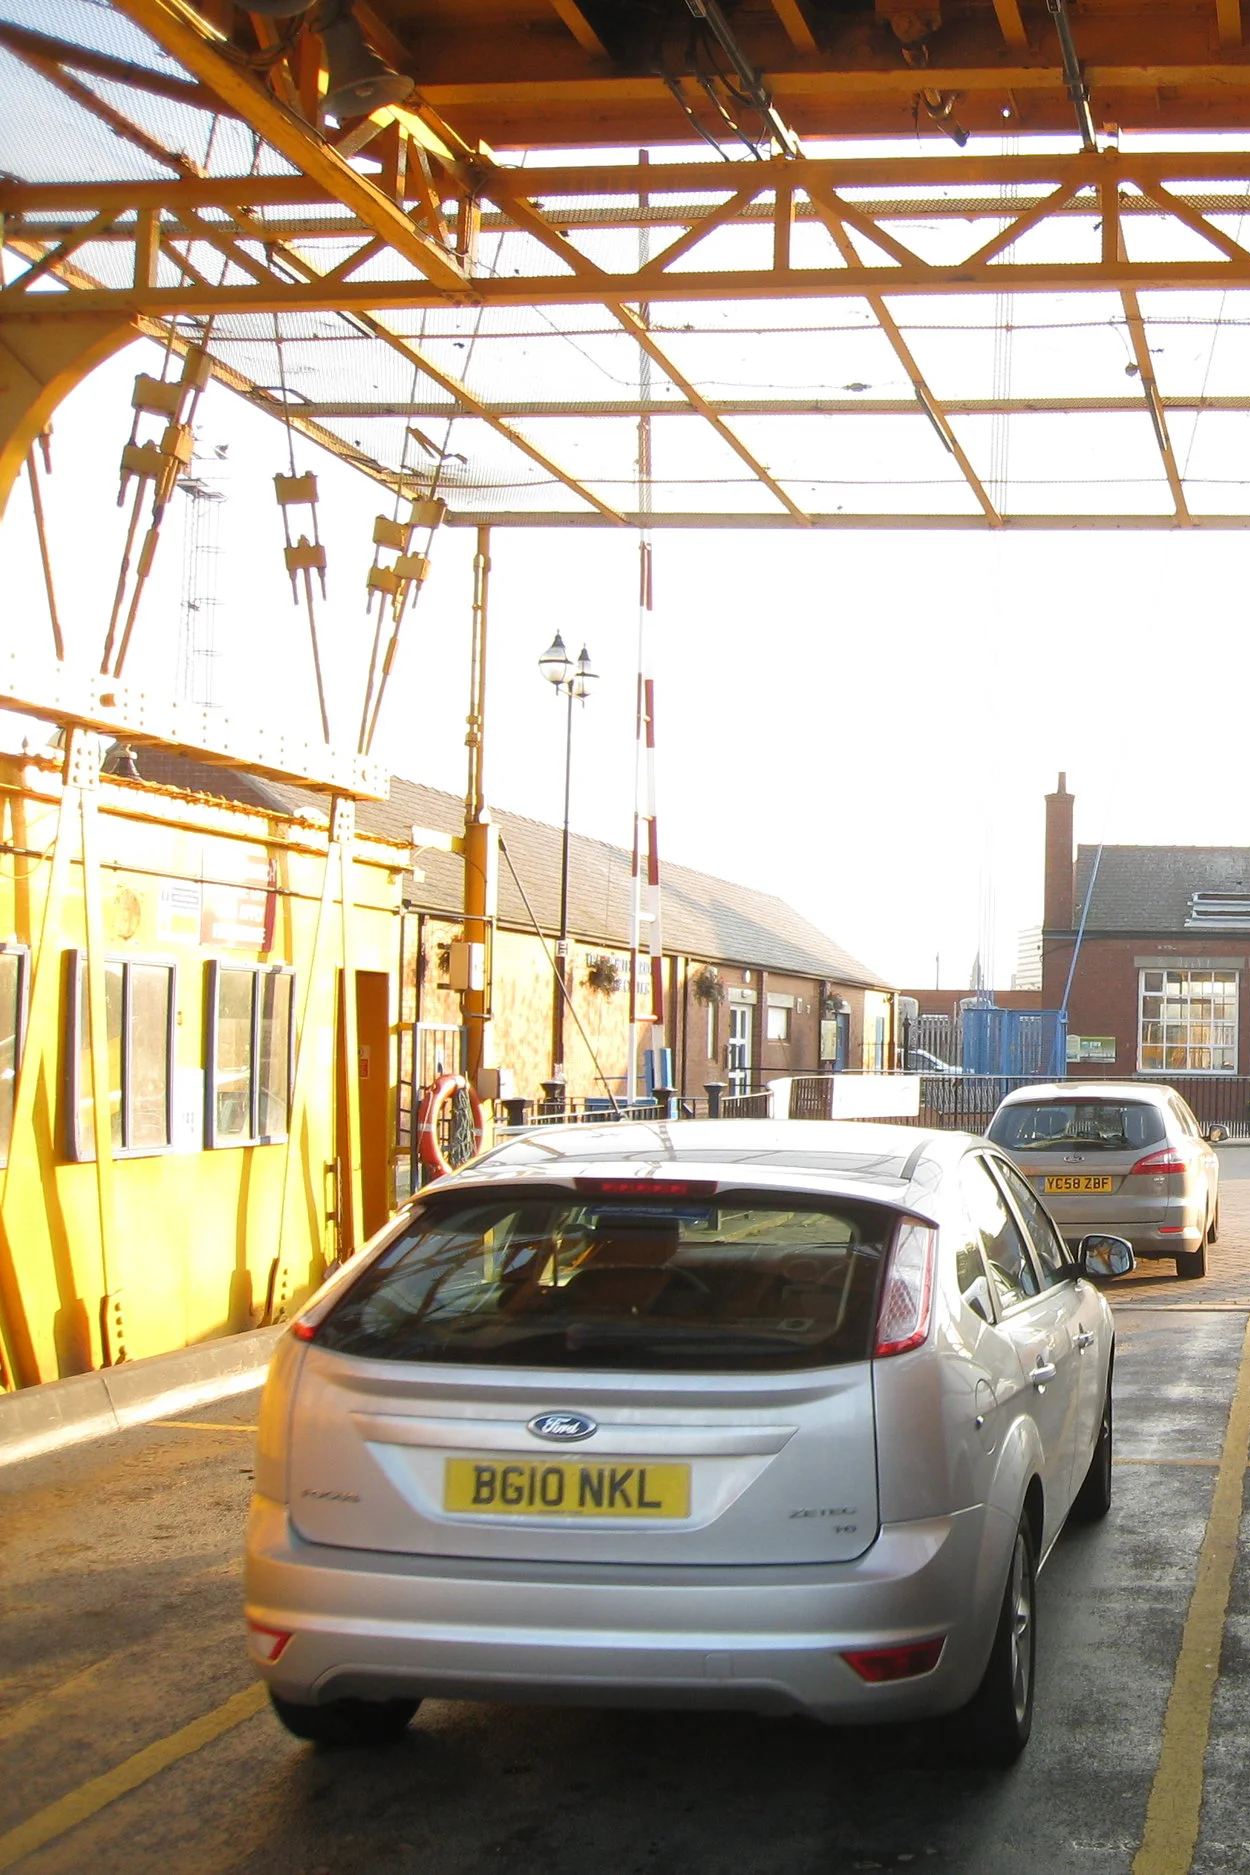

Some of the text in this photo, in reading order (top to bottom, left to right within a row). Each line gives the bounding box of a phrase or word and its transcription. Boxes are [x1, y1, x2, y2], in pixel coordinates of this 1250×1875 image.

[1047, 1177, 1110, 1190] YC58 ZBF
[541, 1415, 582, 1435] Ford
[471, 1464, 663, 1509] BG10 NKL
